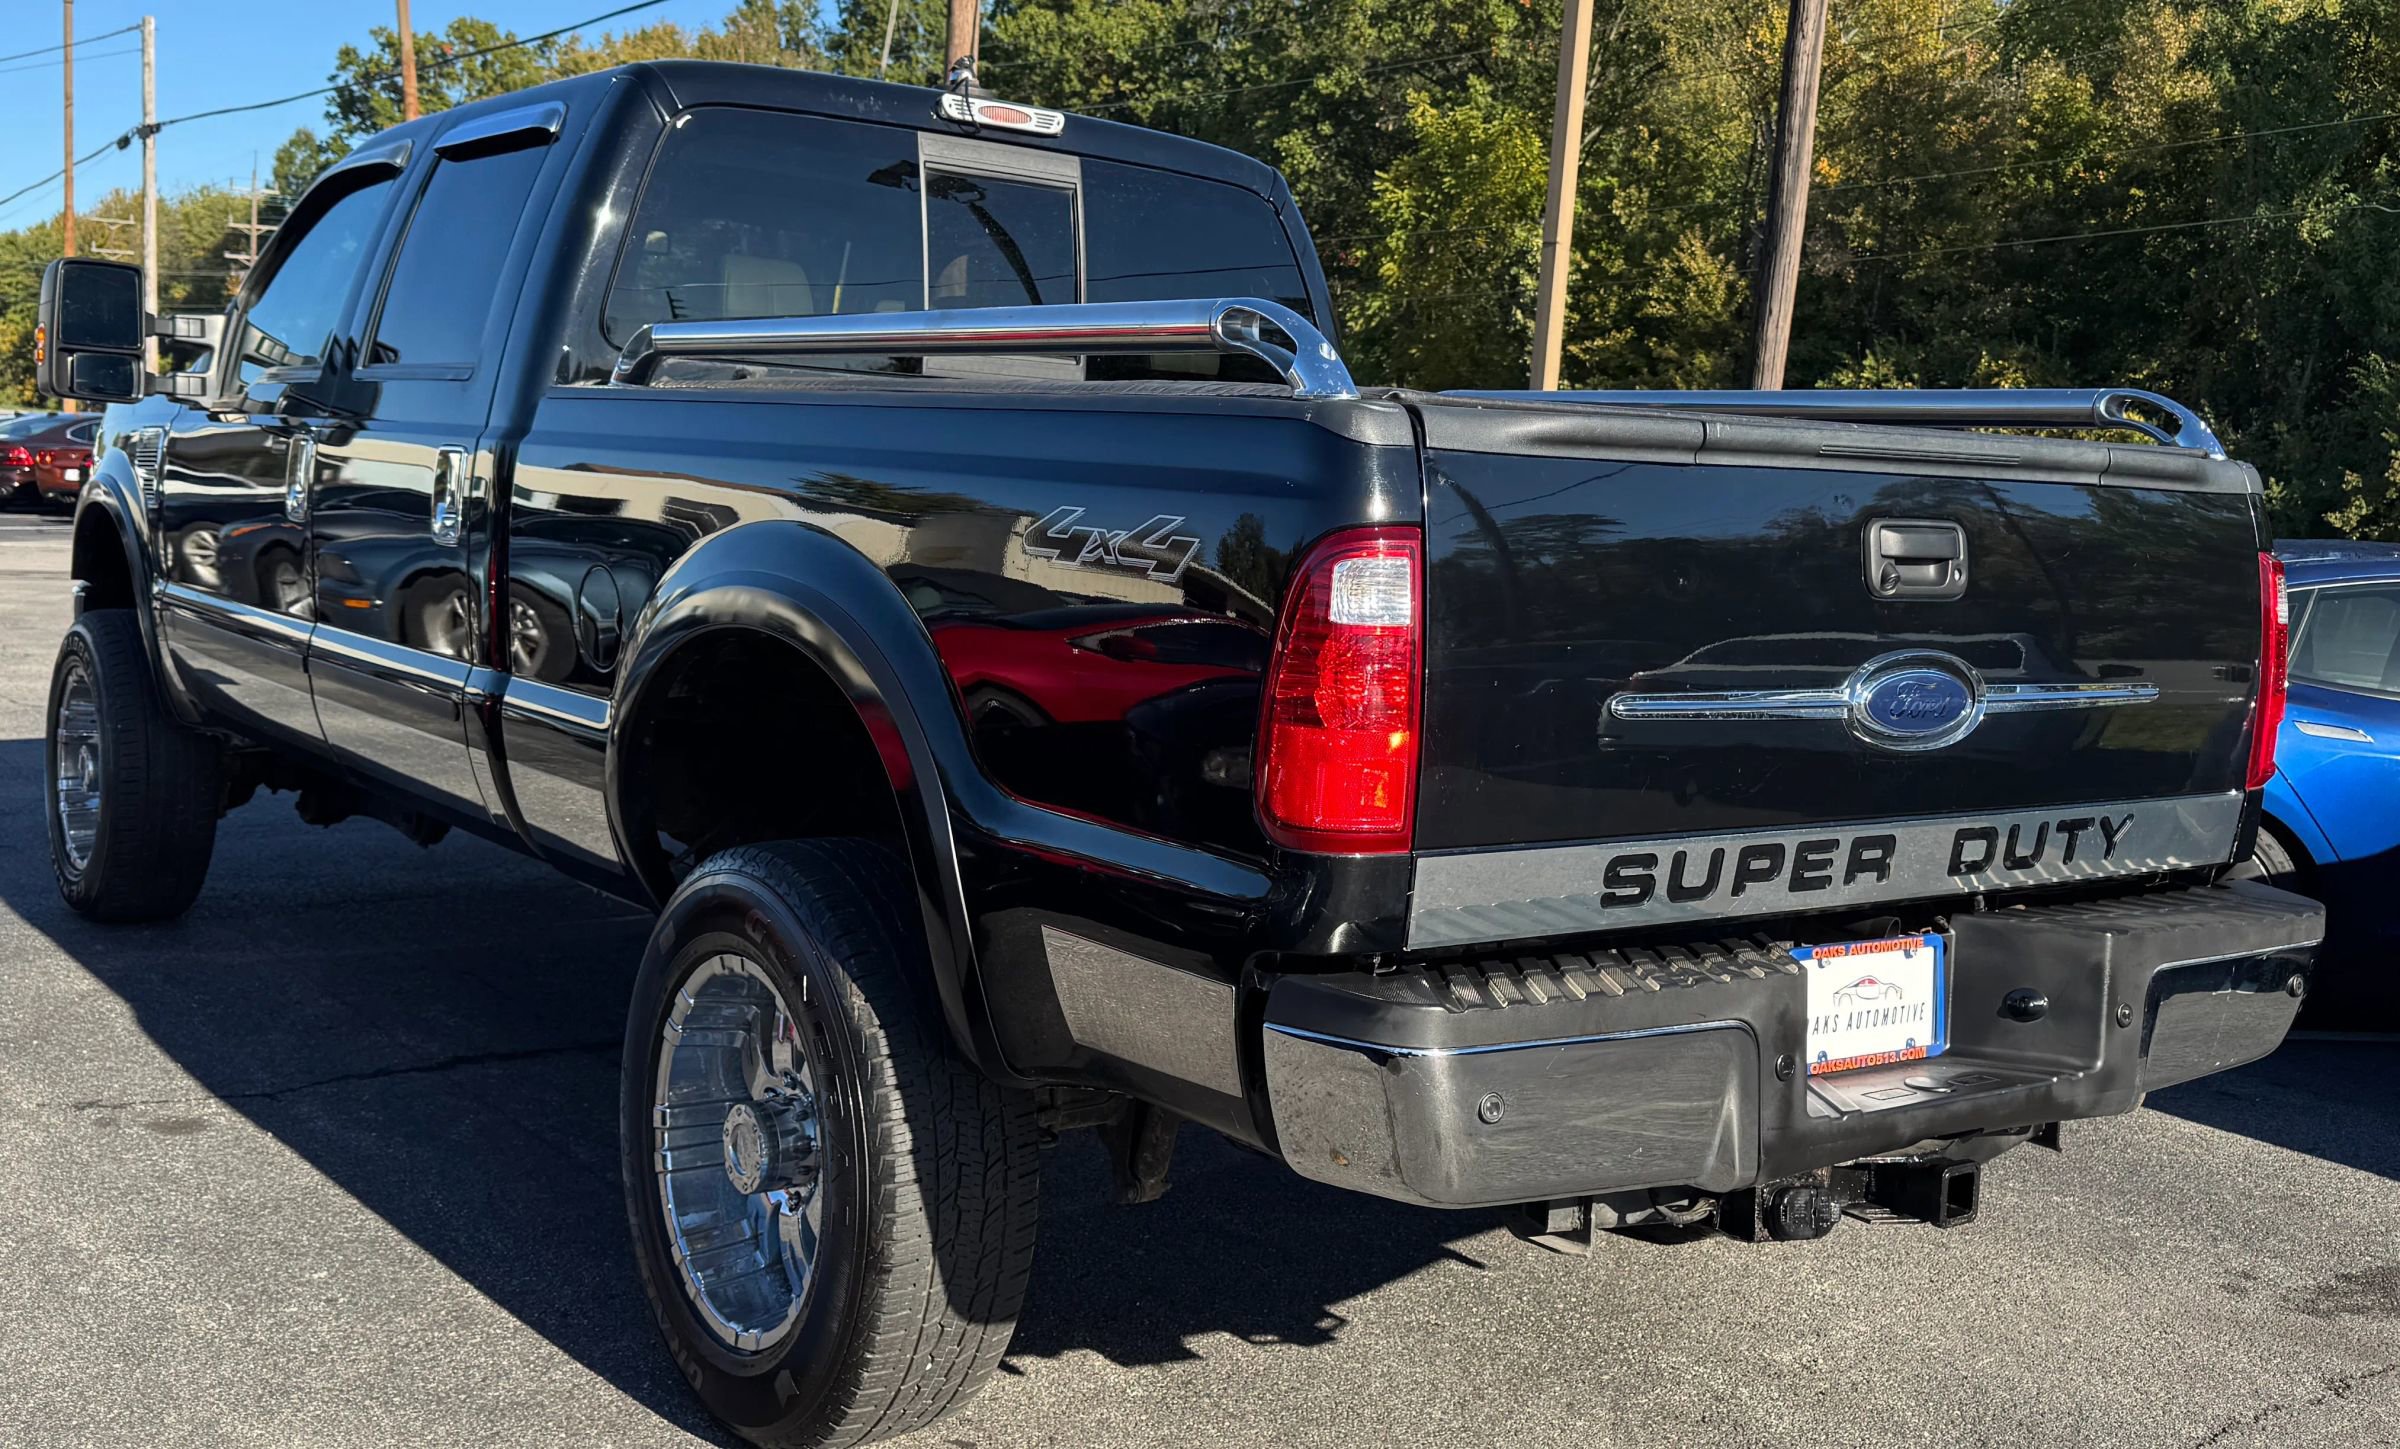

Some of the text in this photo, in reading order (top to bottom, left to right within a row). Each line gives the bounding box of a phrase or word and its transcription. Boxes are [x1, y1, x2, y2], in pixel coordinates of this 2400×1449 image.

[1023, 505, 1201, 583] 4x4
[1889, 680, 1950, 720] Ford
[1600, 812, 2136, 910] SUPER DUTY
[1812, 937, 1925, 959] OAKS AUTOMOTIVE
[1807, 1002, 1926, 1035] AKS AUTOMOTIVE
[1809, 1046, 1927, 1075] OAKSAUTO513.COM
